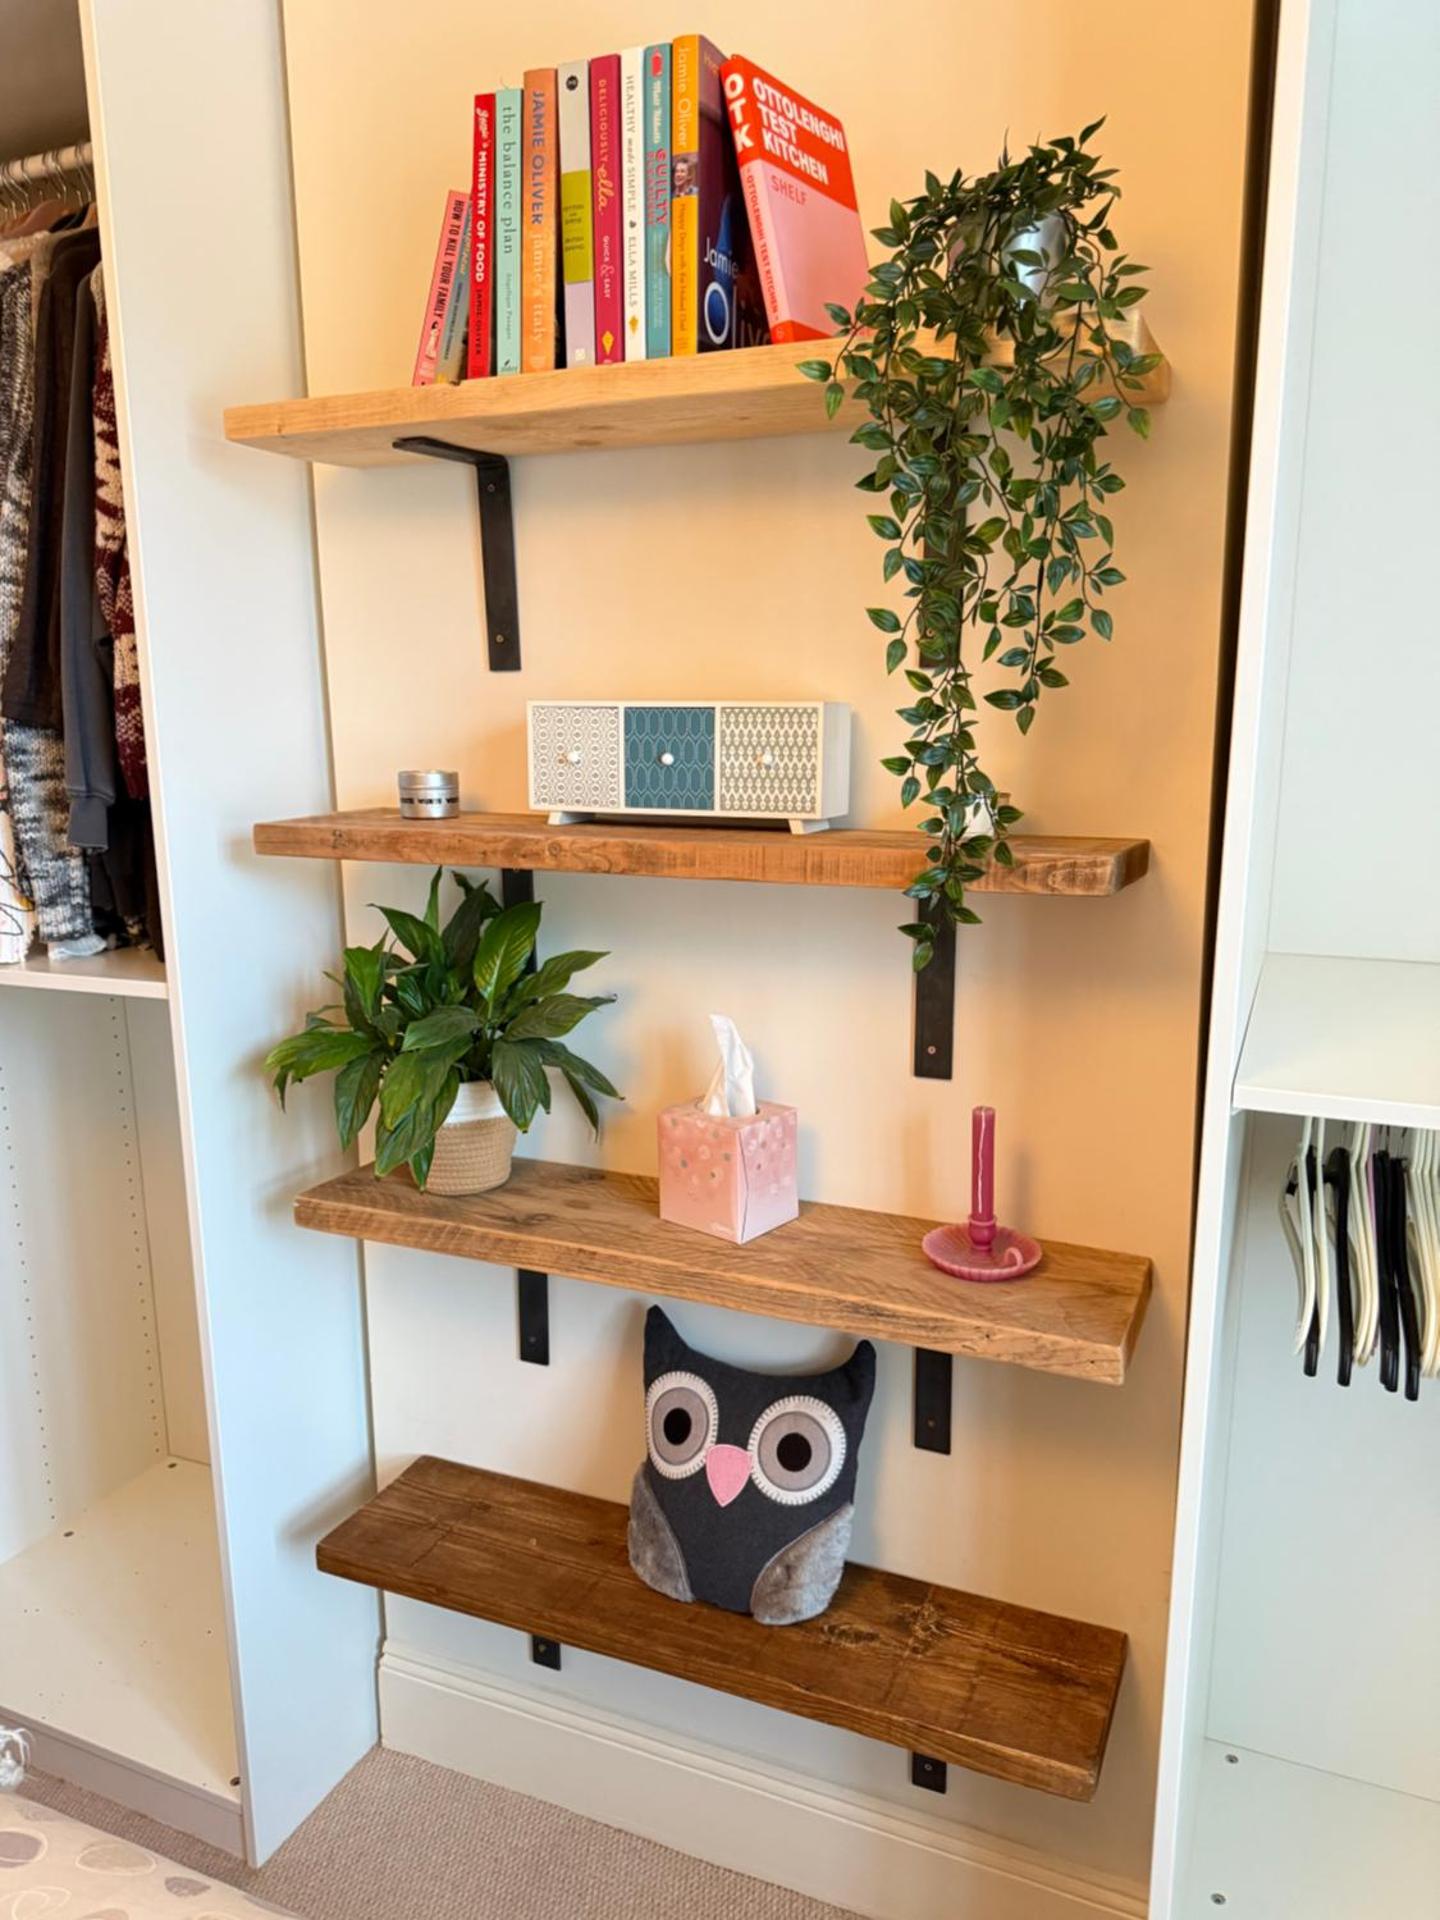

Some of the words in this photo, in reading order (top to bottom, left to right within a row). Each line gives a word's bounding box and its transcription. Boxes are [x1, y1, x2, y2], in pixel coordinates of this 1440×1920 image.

[677, 47, 689, 93] Jamie
[502, 106, 516, 134] the
[531, 91, 544, 147] JAMIE
[598, 79, 609, 161] DELICIOUSLY
[626, 75, 636, 133] HEALTHY
[677, 98, 693, 148] Oliver
[752, 77, 846, 153] OTTOLENGHI
[757, 101, 796, 144] TEST
[502, 141, 517, 209] balance
[761, 127, 829, 186] KITCHEN
[477, 151, 487, 216] MINISTRY
[531, 155, 544, 225] OLIVER
[627, 167, 637, 212] SIMPLE
[655, 147, 668, 225] GUILTY
[771, 175, 808, 206] SHELF
[448, 223, 461, 236] TO
[452, 199, 465, 221] HOW
[476, 220, 486, 239] OF
[444, 237, 458, 257] KILL
[500, 217, 517, 254] plan
[602, 235, 610, 262] QUICK
[628, 236, 637, 266] ELLA
[760, 242, 771, 269] TEST
[440, 261, 454, 286] YOUR
[475, 243, 486, 283] FOOD
[600, 264, 615, 278] &
[703, 236, 740, 279] Jamie
[434, 286, 449, 320] FAMILY
[603, 279, 611, 299] EASY
[628, 272, 638, 307] MILLS
[765, 269, 779, 313] KITCHEN
